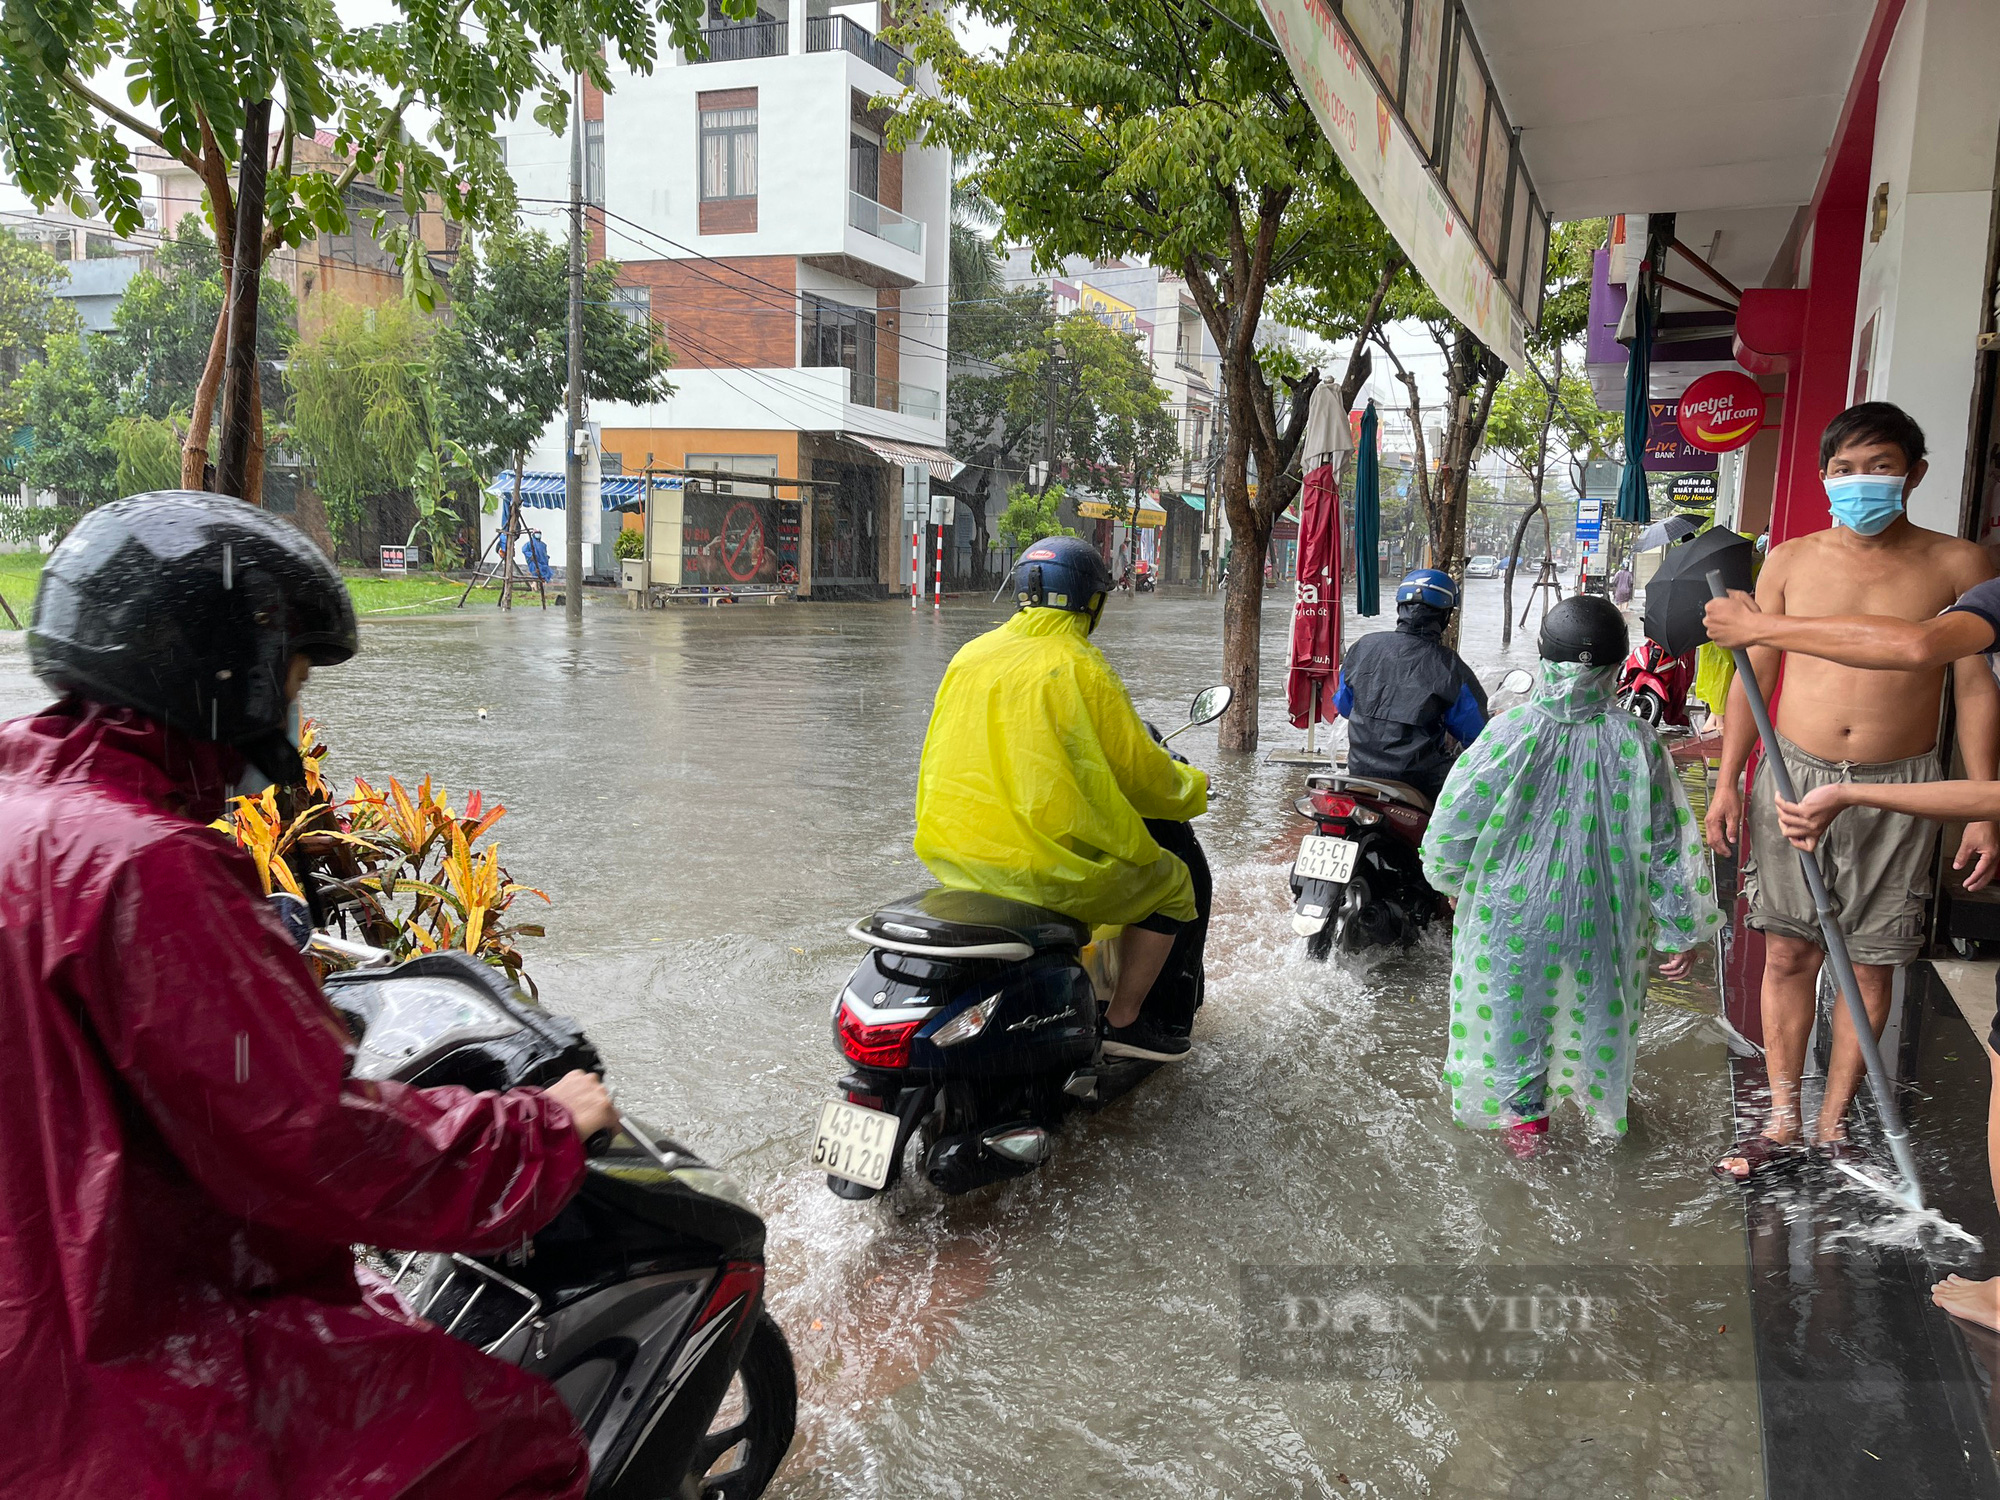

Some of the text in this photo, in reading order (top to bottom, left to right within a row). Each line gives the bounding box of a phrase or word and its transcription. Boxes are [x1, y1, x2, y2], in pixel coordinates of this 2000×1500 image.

[1685, 394, 1734, 418] Vietjet
[1710, 407, 1758, 426] Air.com
[1645, 438, 1677, 453] Live
[1309, 839, 1347, 861] 43-C1
[1299, 856, 1349, 879] 941.76
[829, 1106, 886, 1147] 43-C1
[814, 1136, 886, 1182] 581.28
